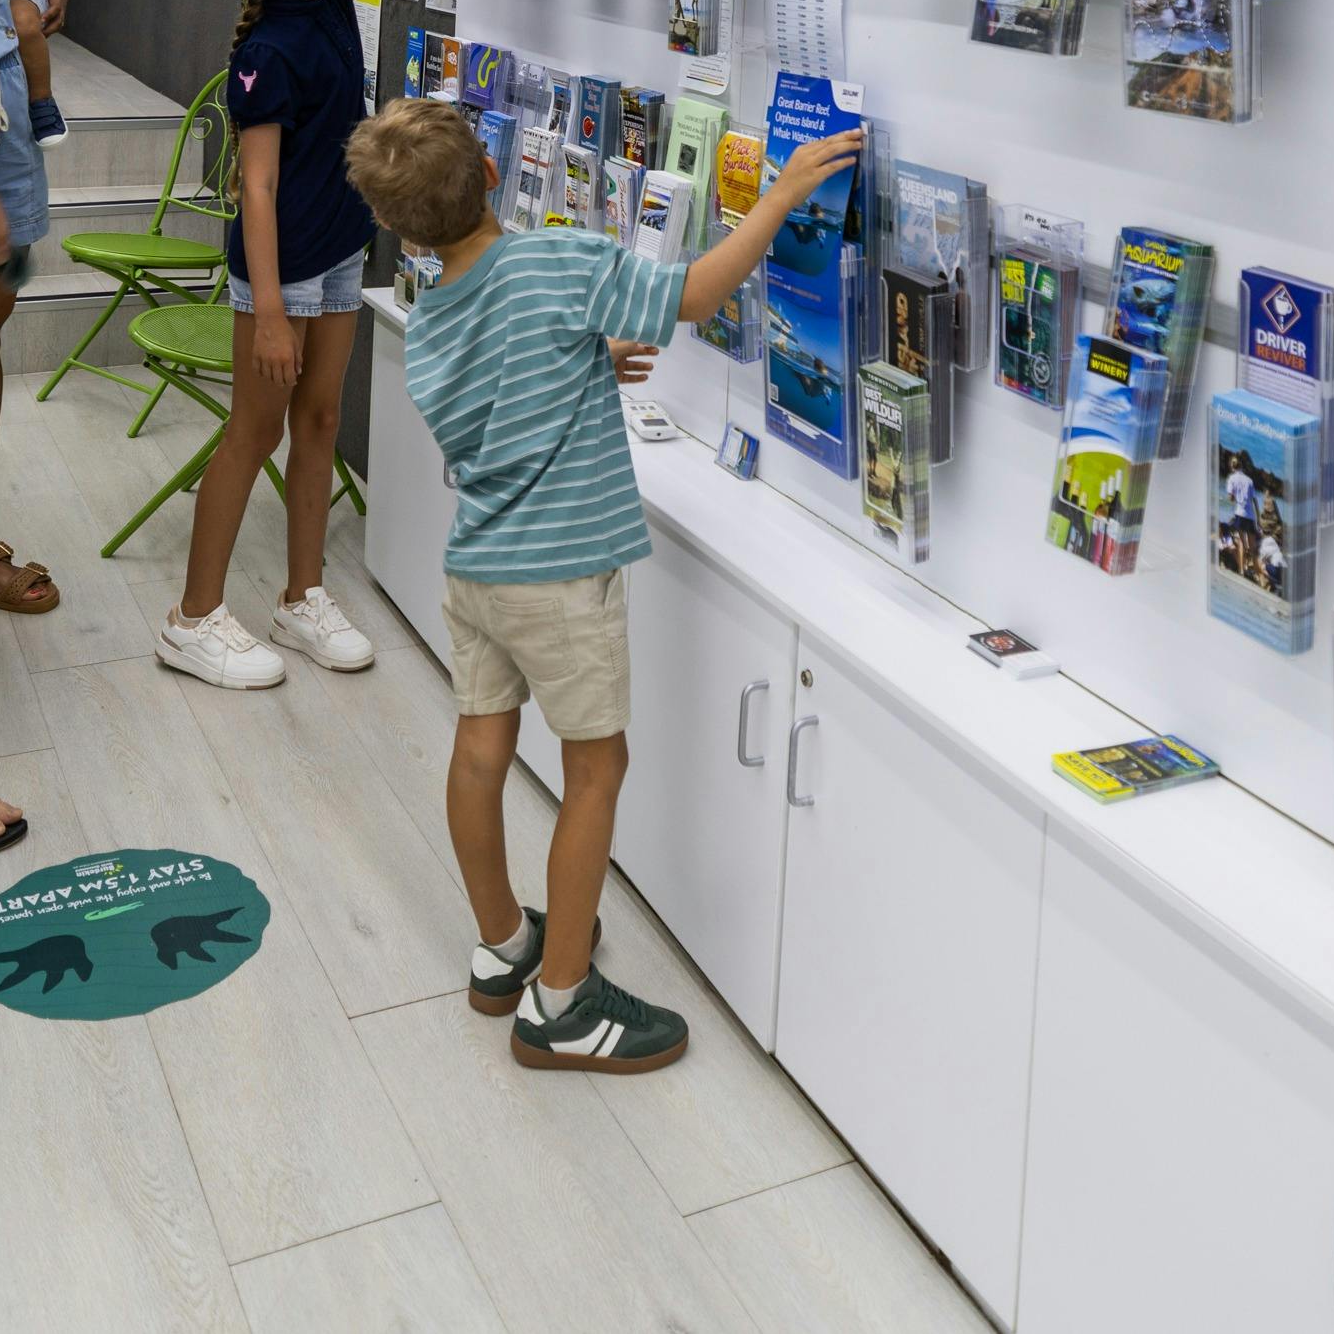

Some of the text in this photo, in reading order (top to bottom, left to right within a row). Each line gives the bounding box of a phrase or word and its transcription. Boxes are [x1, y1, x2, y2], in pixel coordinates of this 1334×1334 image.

[777, 96, 831, 117] Great Barrier Reef,
[775, 111, 826, 131] Orpheus Island &
[773, 126, 792, 140] Whale
[897, 176, 958, 205] QUEENSLAND
[1255, 328, 1307, 359] DRIVER
[1255, 345, 1306, 372] REVIVER
[1090, 358, 1128, 381] WINERY
[865, 387, 882, 402] BEST
[75, 863, 114, 878] Burdekin
[148, 858, 205, 882] STAY
[198, 872, 212, 881] Be
[78, 872, 140, 894] 1.5M
[146, 879, 171, 894] and
[174, 873, 196, 886] safe
[95, 892, 114, 902] the
[116, 884, 146, 898] enjoy
[36, 903, 64, 917] open
[67, 896, 93, 910] wide
